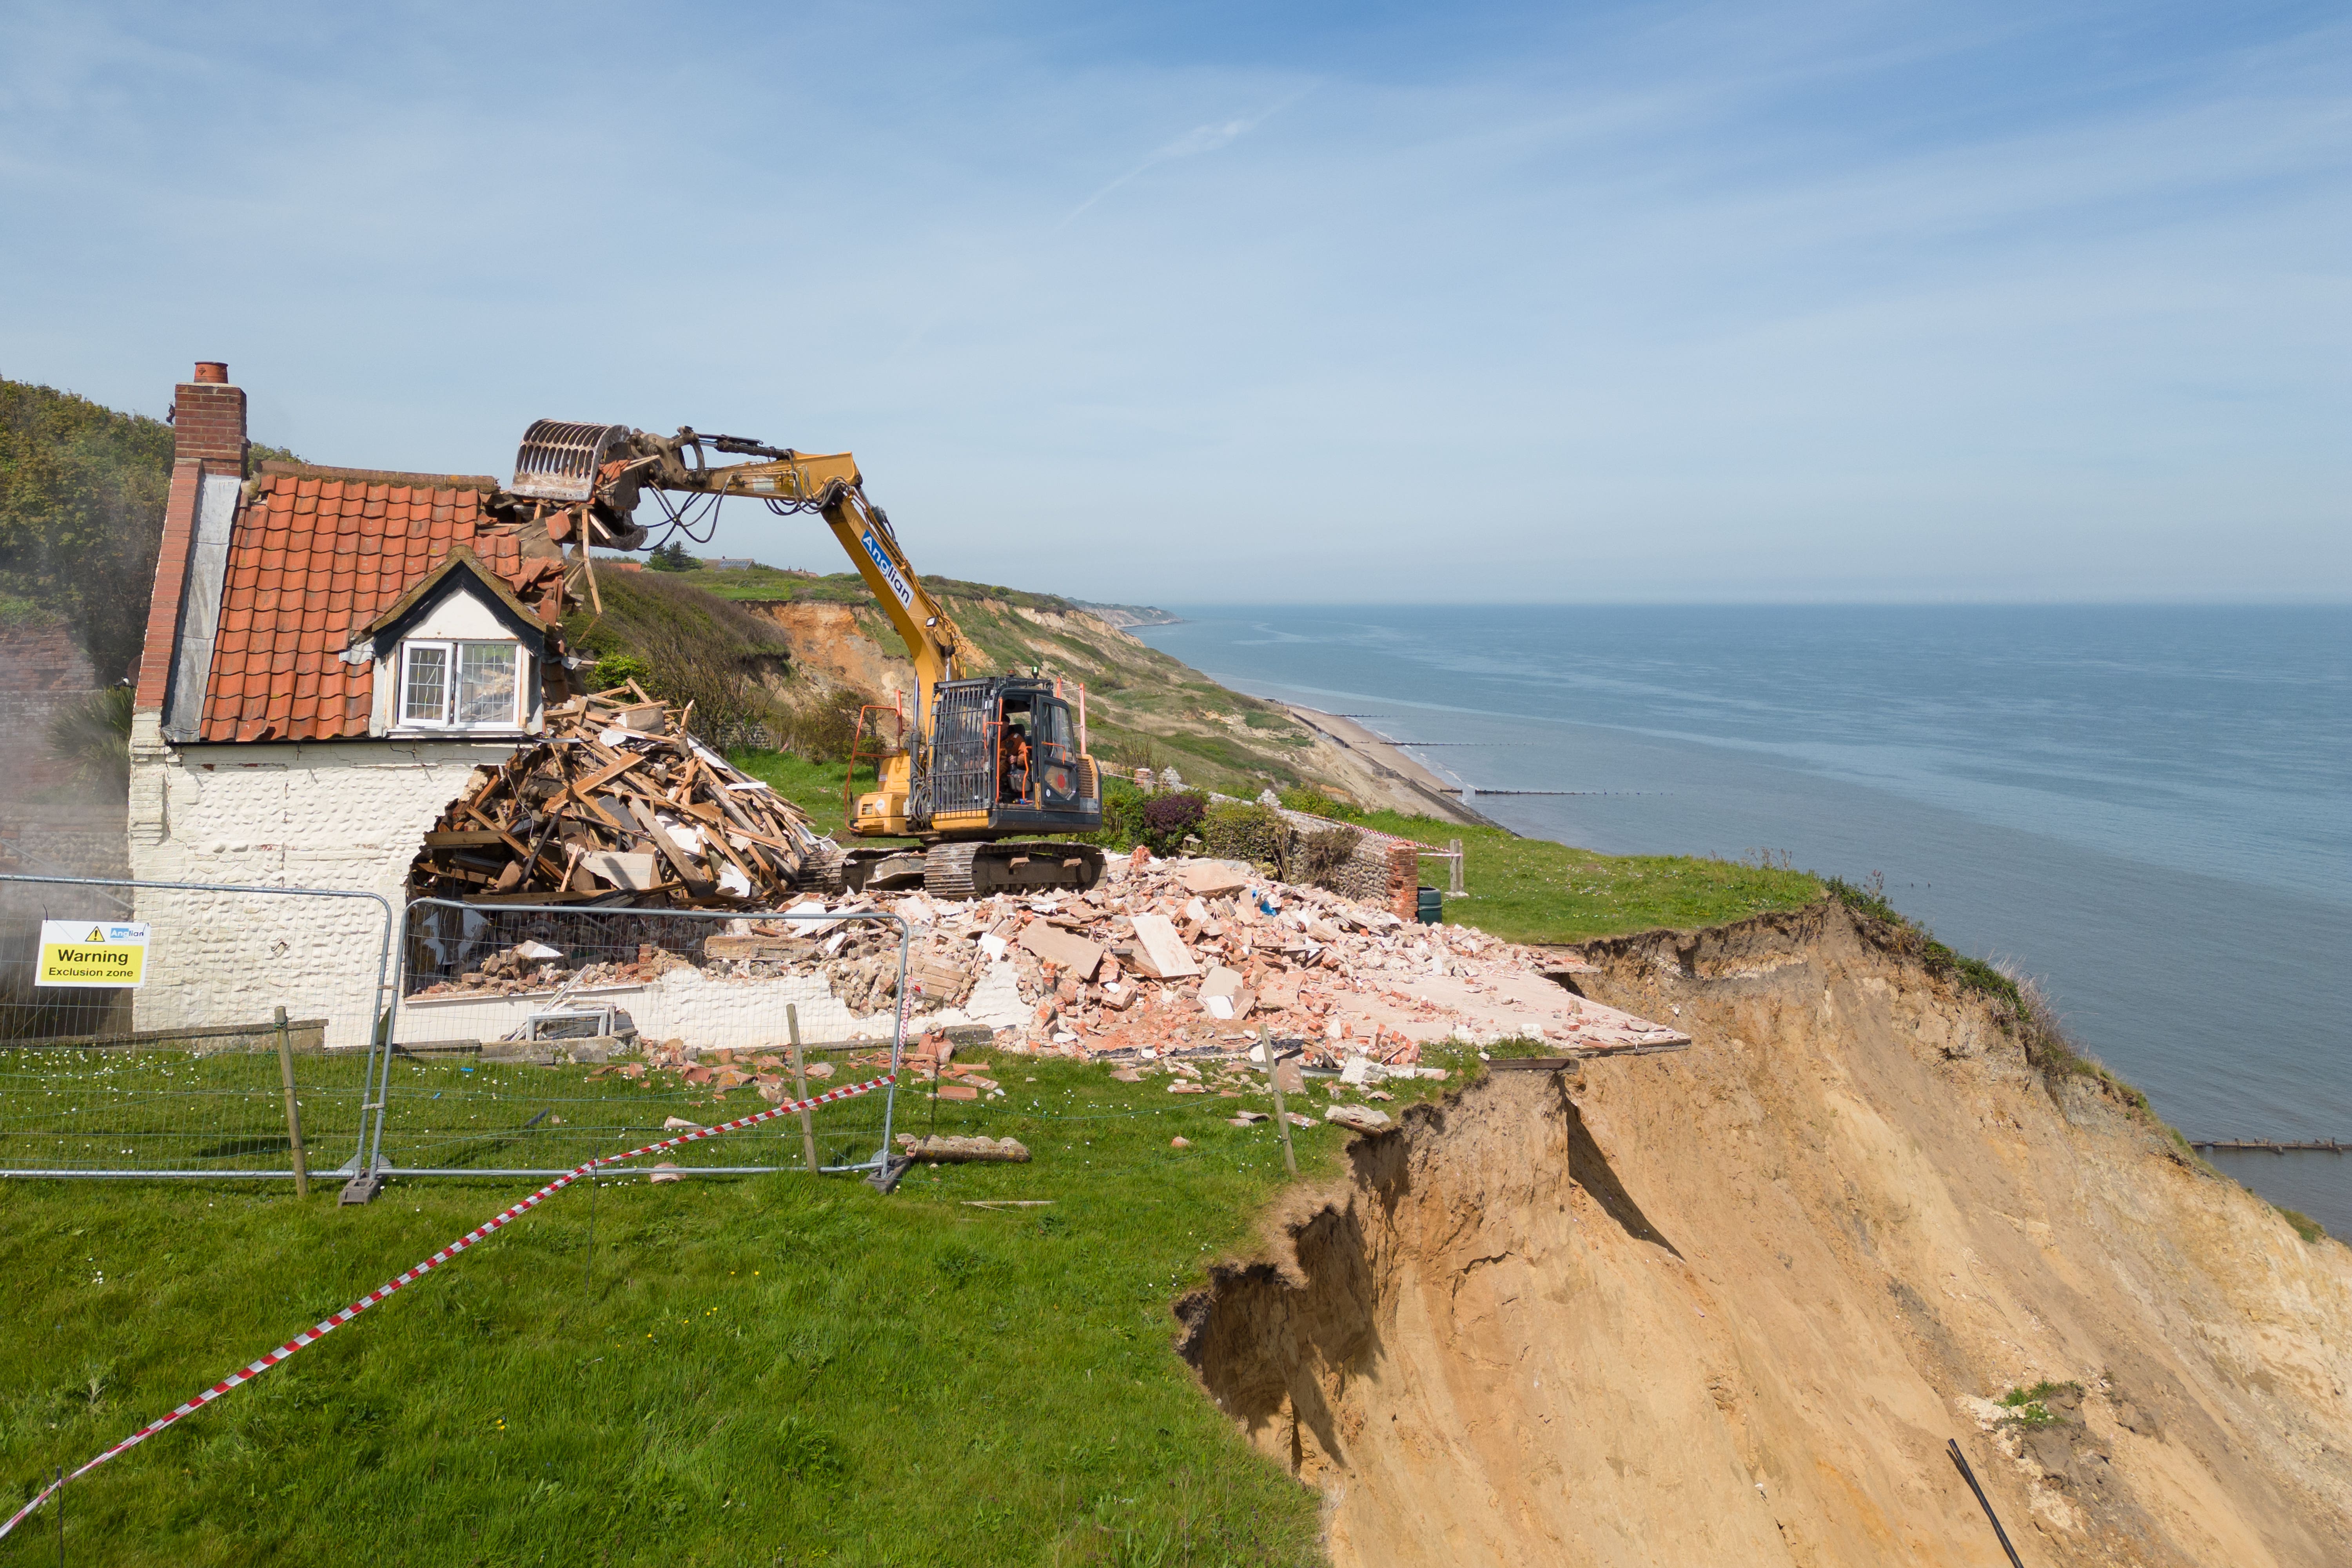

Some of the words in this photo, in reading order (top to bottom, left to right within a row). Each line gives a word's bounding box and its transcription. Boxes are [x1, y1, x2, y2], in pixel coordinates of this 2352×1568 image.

[863, 536, 909, 603] Anglian
[111, 929, 143, 938] Anglian
[58, 949, 128, 965] Warning
[49, 967, 103, 976] Exclusion
